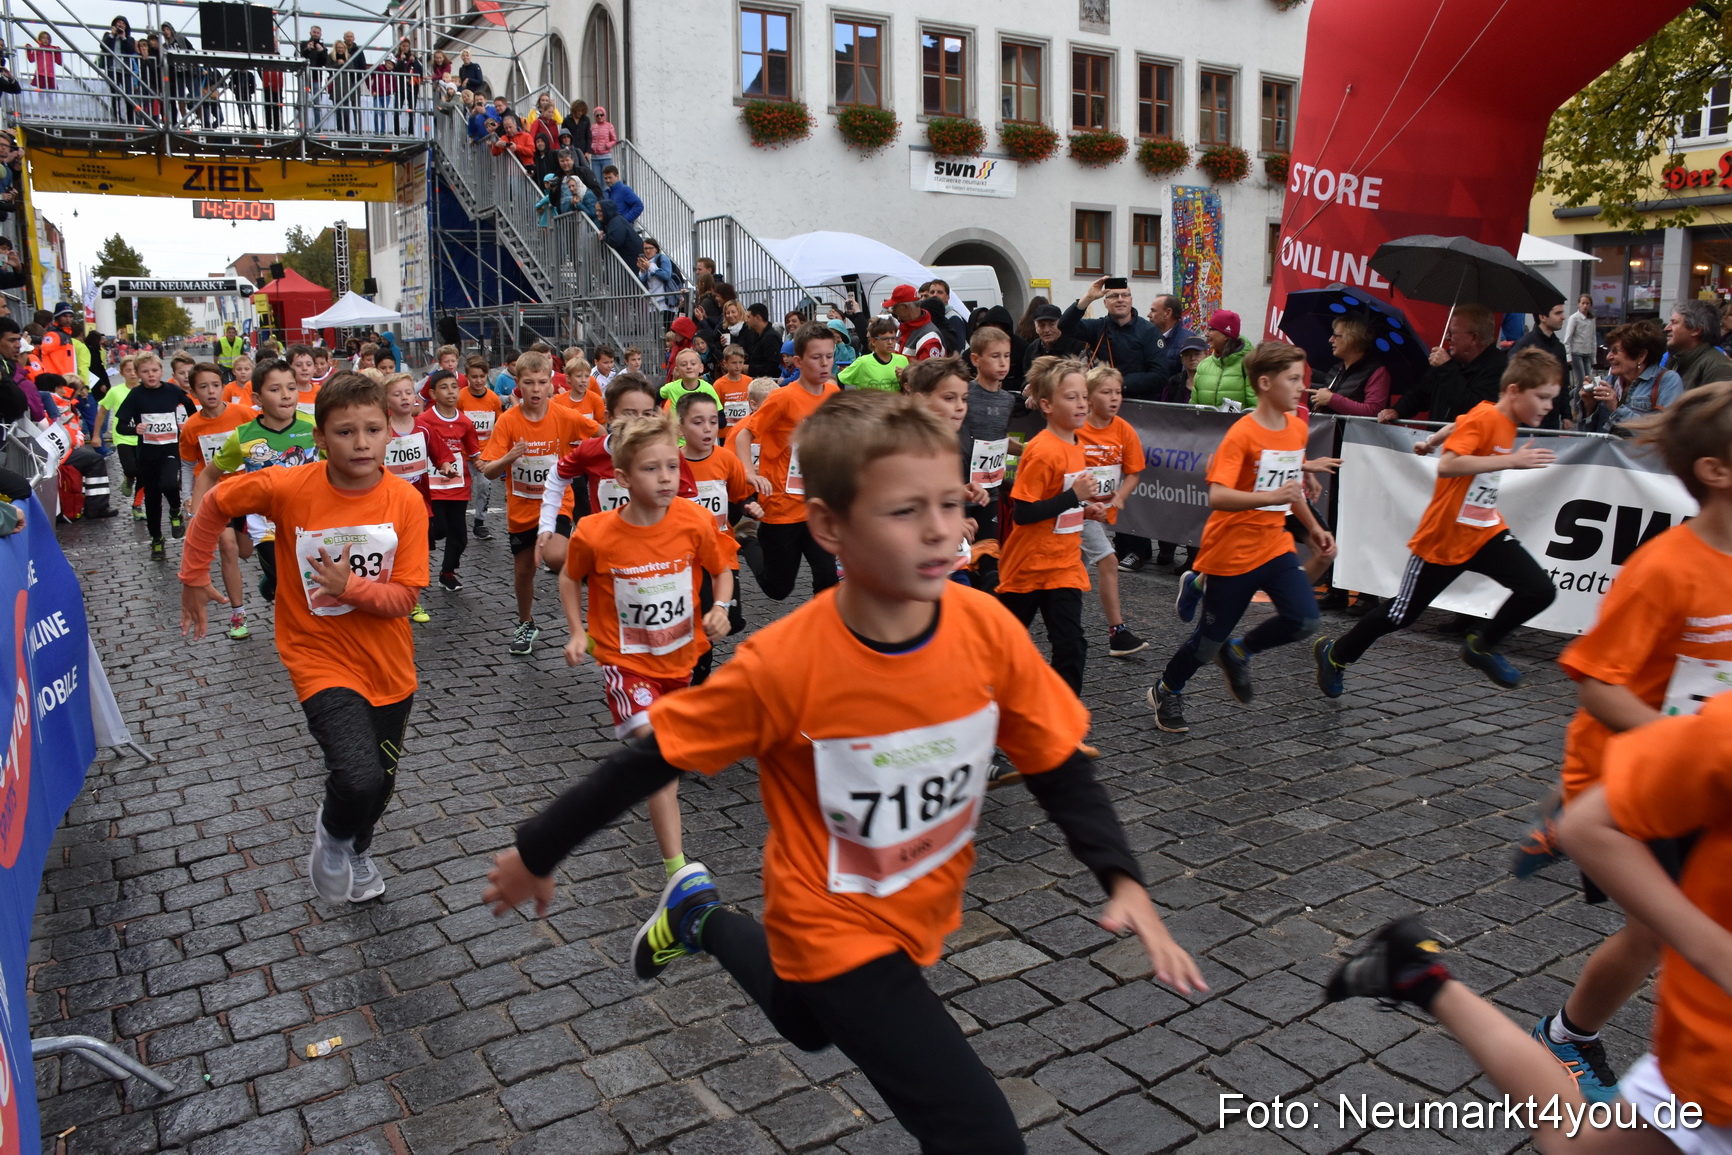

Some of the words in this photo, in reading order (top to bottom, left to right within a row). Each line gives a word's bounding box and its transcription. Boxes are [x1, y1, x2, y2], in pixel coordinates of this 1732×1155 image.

[51, 170, 99, 180] Neumarkter
[100, 174, 136, 183] Stadtlauf
[934, 161, 976, 178] swn
[183, 164, 264, 192] ZIEL
[306, 181, 347, 189] Neumarkter
[348, 181, 378, 189] Stadtlauf
[1291, 162, 1383, 210] STORE
[1663, 166, 1716, 190] Der
[129, 280, 156, 291] MINI
[160, 280, 227, 292] NEUMARKT.
[729, 409, 746, 417] 7025
[148, 422, 173, 434] 7323
[473, 421, 490, 430] 041
[390, 447, 421, 463] 7065
[979, 453, 1005, 470] 7102
[334, 535, 367, 544] BOCK
[628, 596, 685, 626] 7234
[36, 665, 78, 721] MOBILE
[850, 763, 972, 838] 7182
